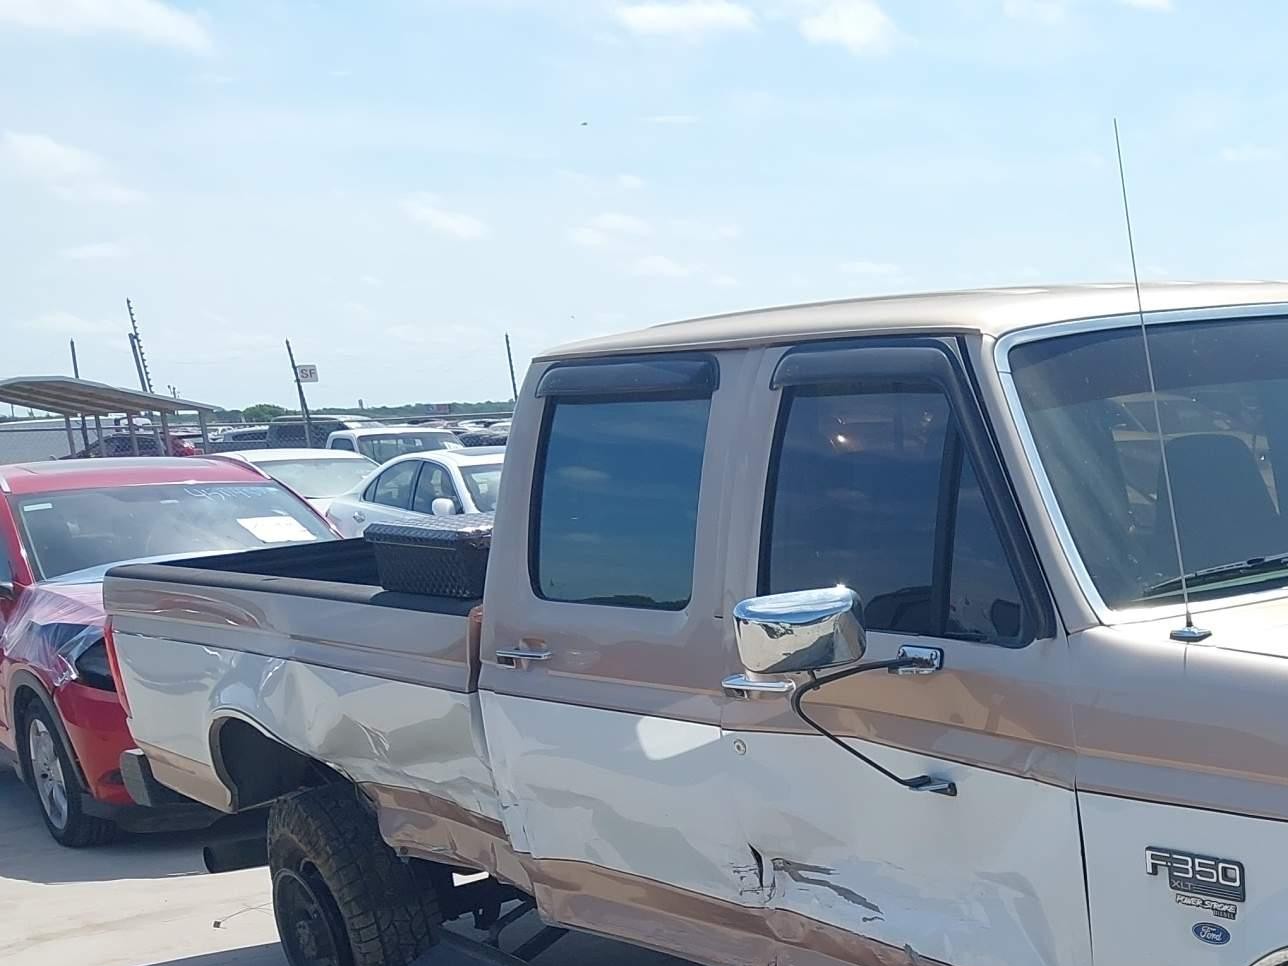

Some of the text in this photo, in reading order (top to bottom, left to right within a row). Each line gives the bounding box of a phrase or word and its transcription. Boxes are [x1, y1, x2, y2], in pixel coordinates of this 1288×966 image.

[300, 368, 316, 379] SF
[1171, 880, 1193, 891] XLT
[1176, 894, 1236, 914] POWER STROKE
